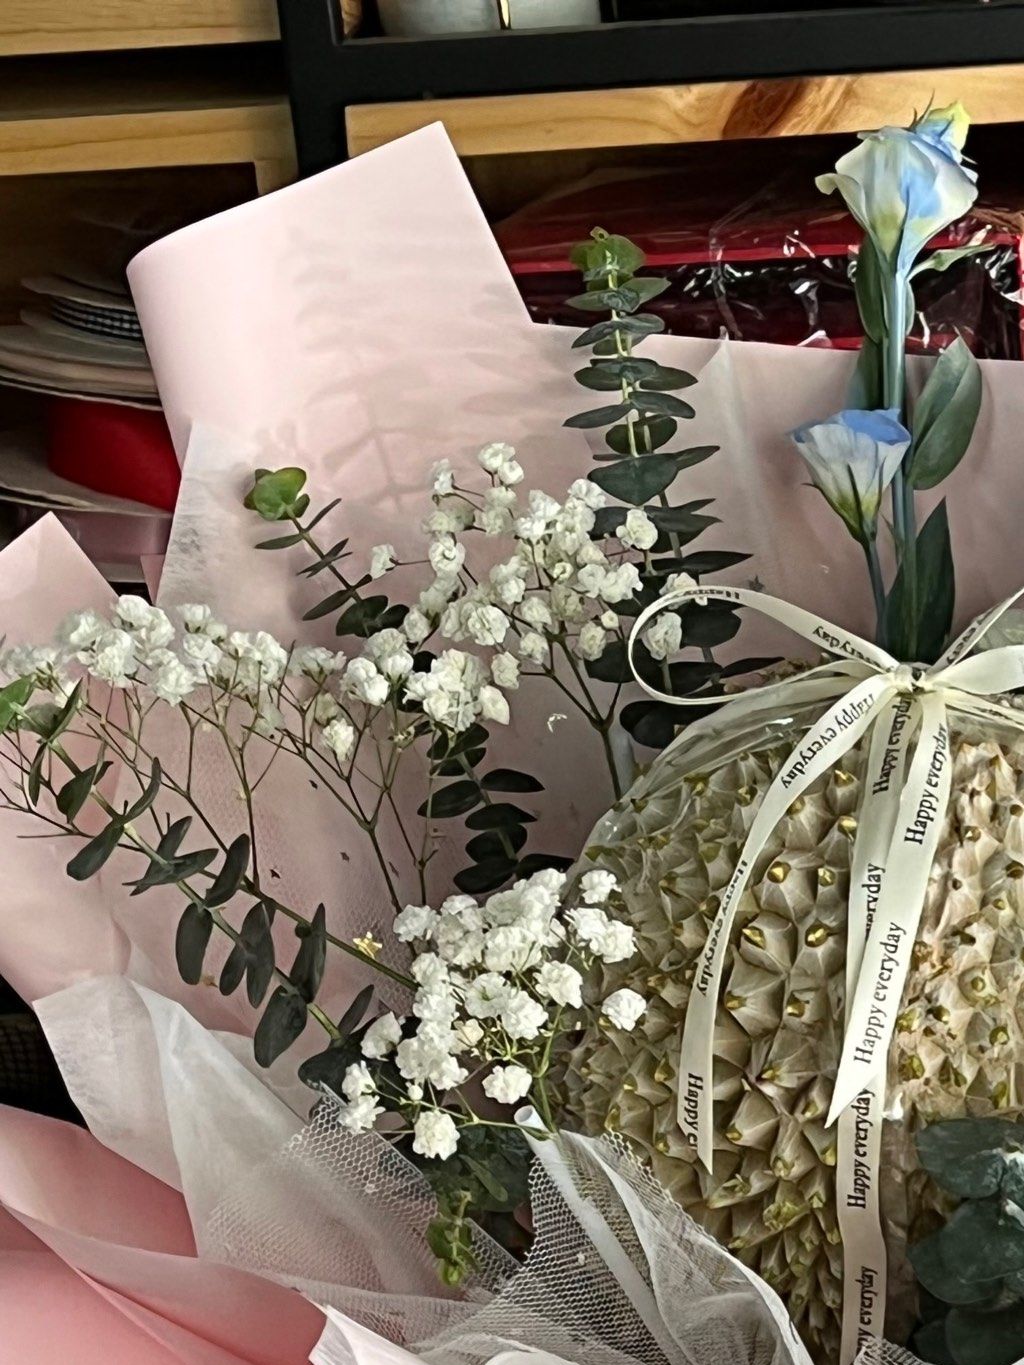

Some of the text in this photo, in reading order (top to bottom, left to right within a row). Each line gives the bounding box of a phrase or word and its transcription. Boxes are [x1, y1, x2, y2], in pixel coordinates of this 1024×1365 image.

[780, 727, 838, 789] everyday
[873, 748, 900, 795] Happy
[904, 787, 940, 845] Happy
[853, 921, 908, 1065] Happy everyday
[684, 1072, 704, 1132] Happy
[847, 1087, 876, 1210] Happy everyday
[854, 1265, 879, 1327] everyday
